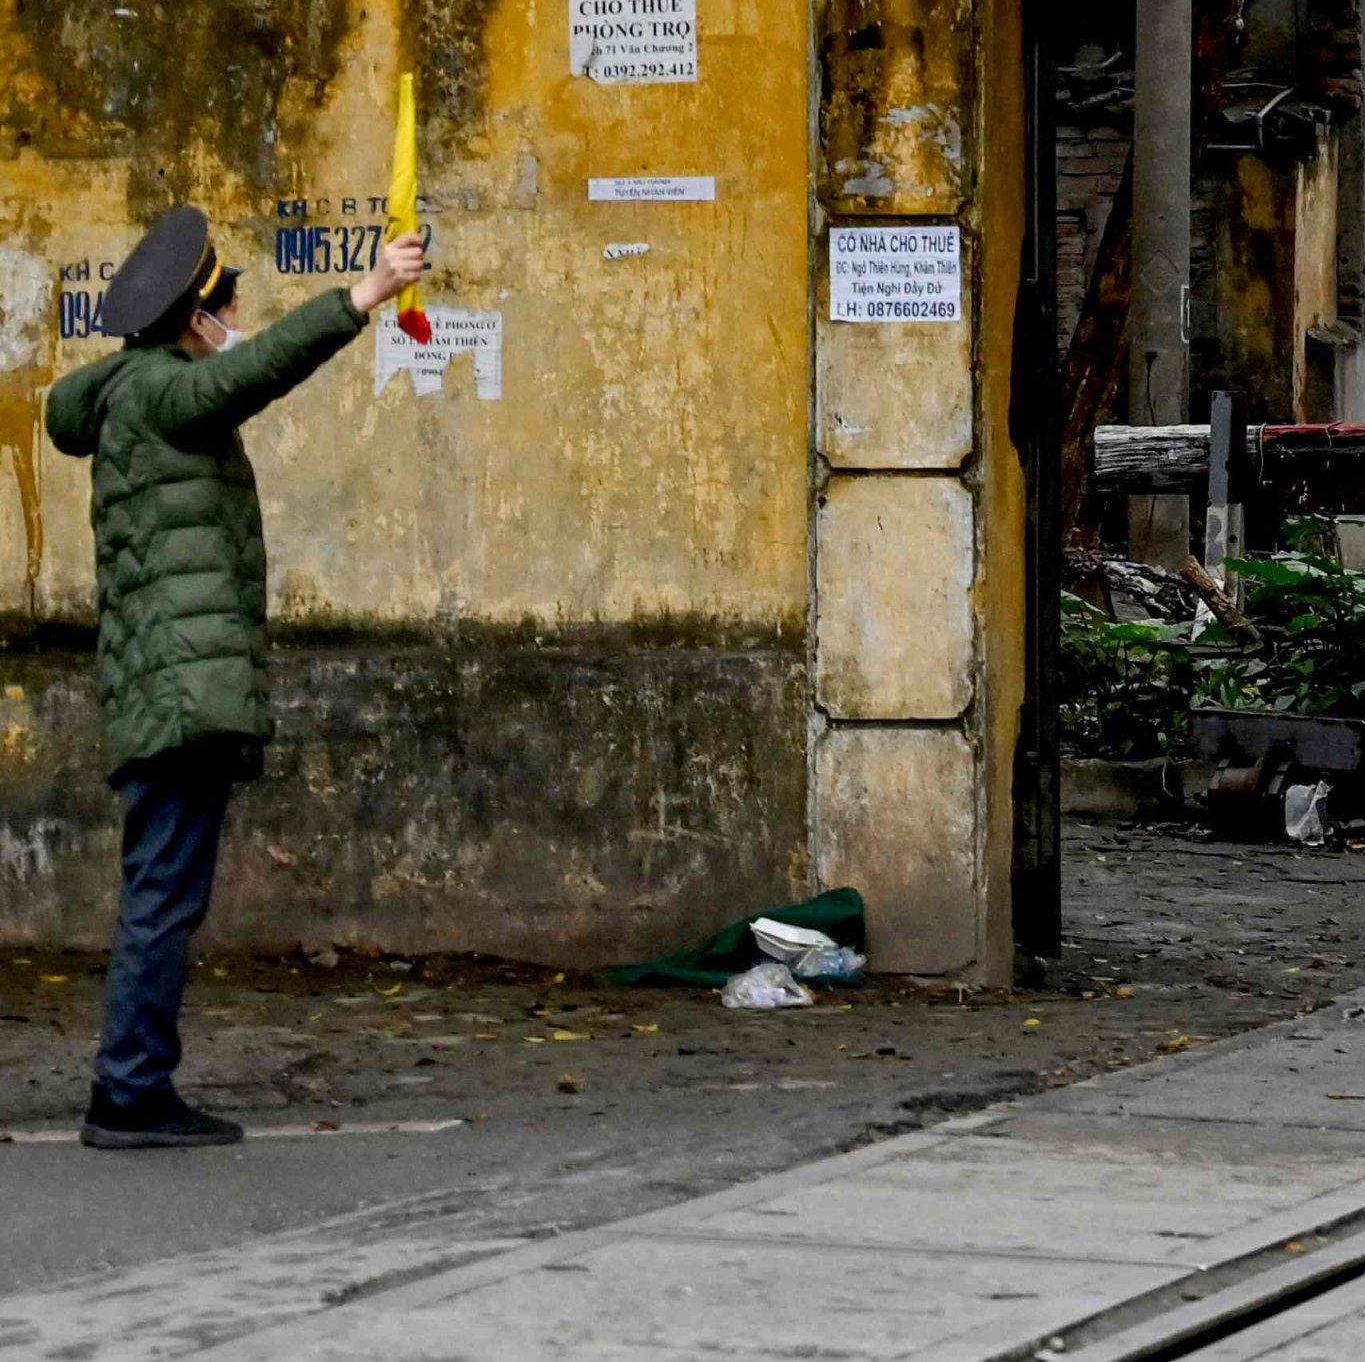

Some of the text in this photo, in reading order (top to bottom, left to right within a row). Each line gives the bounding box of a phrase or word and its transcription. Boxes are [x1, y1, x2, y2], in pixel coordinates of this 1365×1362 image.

[579, 0, 623, 16] CHO
[648, 21, 690, 40] TRỌ
[603, 62, 695, 79] 0392.292.412
[837, 230, 955, 253] CÓ NHÀ CHO THUÊ
[837, 301, 955, 318] LH: 0876602469
